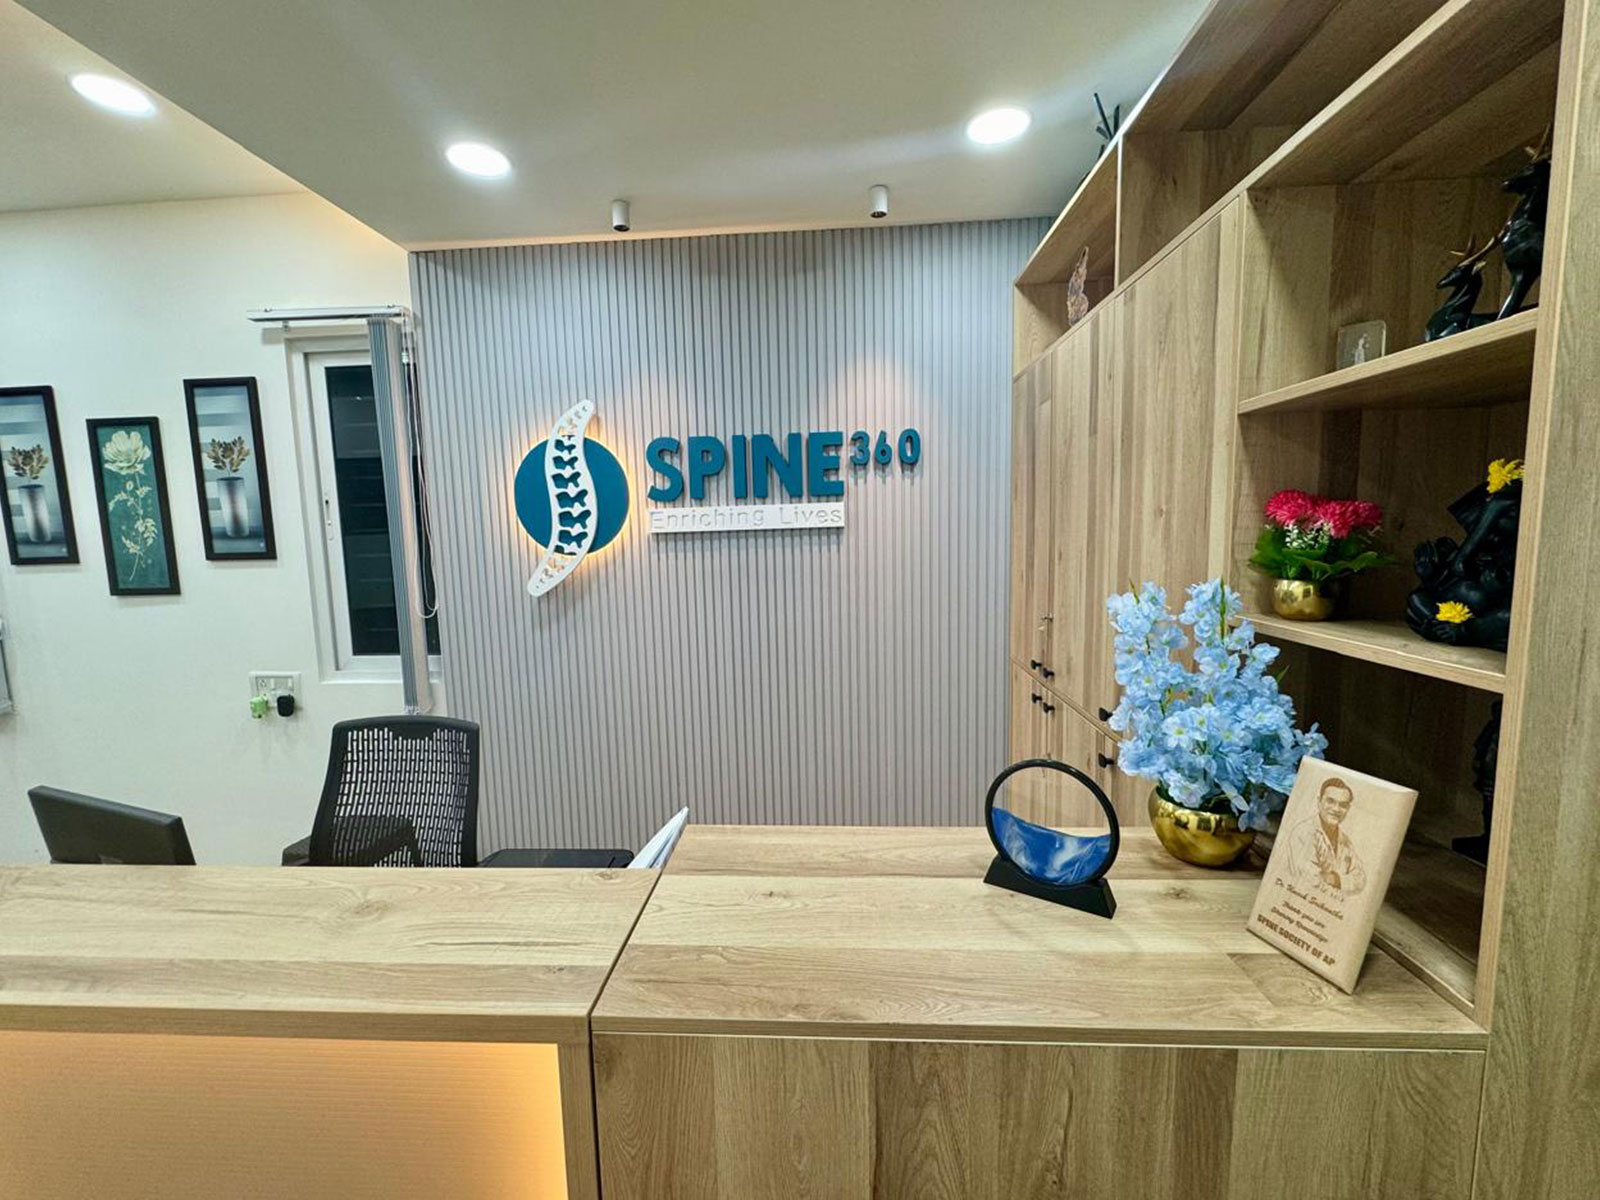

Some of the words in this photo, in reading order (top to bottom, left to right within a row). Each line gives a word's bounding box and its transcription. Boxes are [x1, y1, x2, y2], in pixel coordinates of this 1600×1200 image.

[650, 507, 764, 530] Enriching
[779, 506, 842, 525] Lives
[1257, 914, 1280, 933] SPINE
[1278, 927, 1311, 952] SOCIETY
[1311, 946, 1323, 959] OF
[1322, 954, 1336, 966] AP
